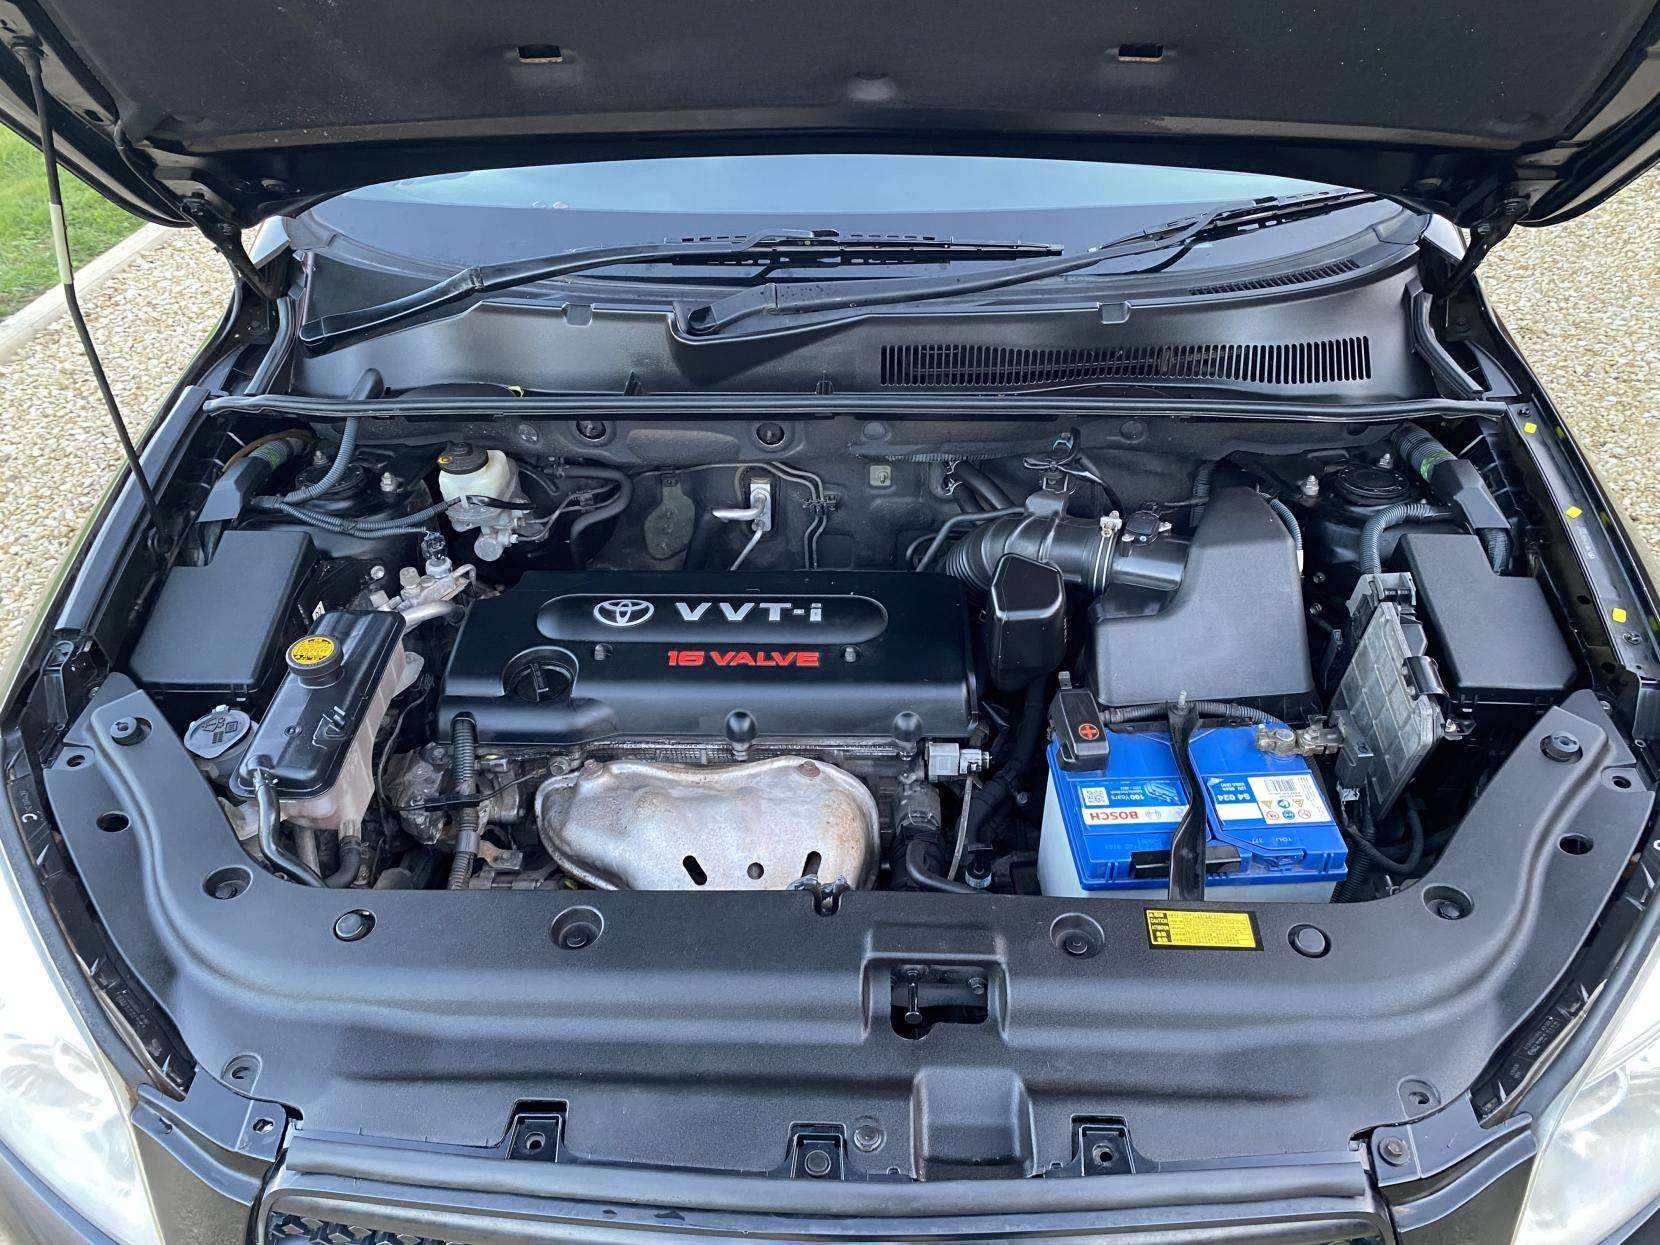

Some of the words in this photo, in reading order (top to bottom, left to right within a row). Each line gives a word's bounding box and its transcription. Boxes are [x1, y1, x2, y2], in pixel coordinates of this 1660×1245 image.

[675, 602, 822, 622] VVT-i
[667, 650, 705, 667] 16
[708, 650, 820, 667] VALVE
[1110, 793, 1130, 801] Years
[1089, 810, 1139, 821] BOSCH
